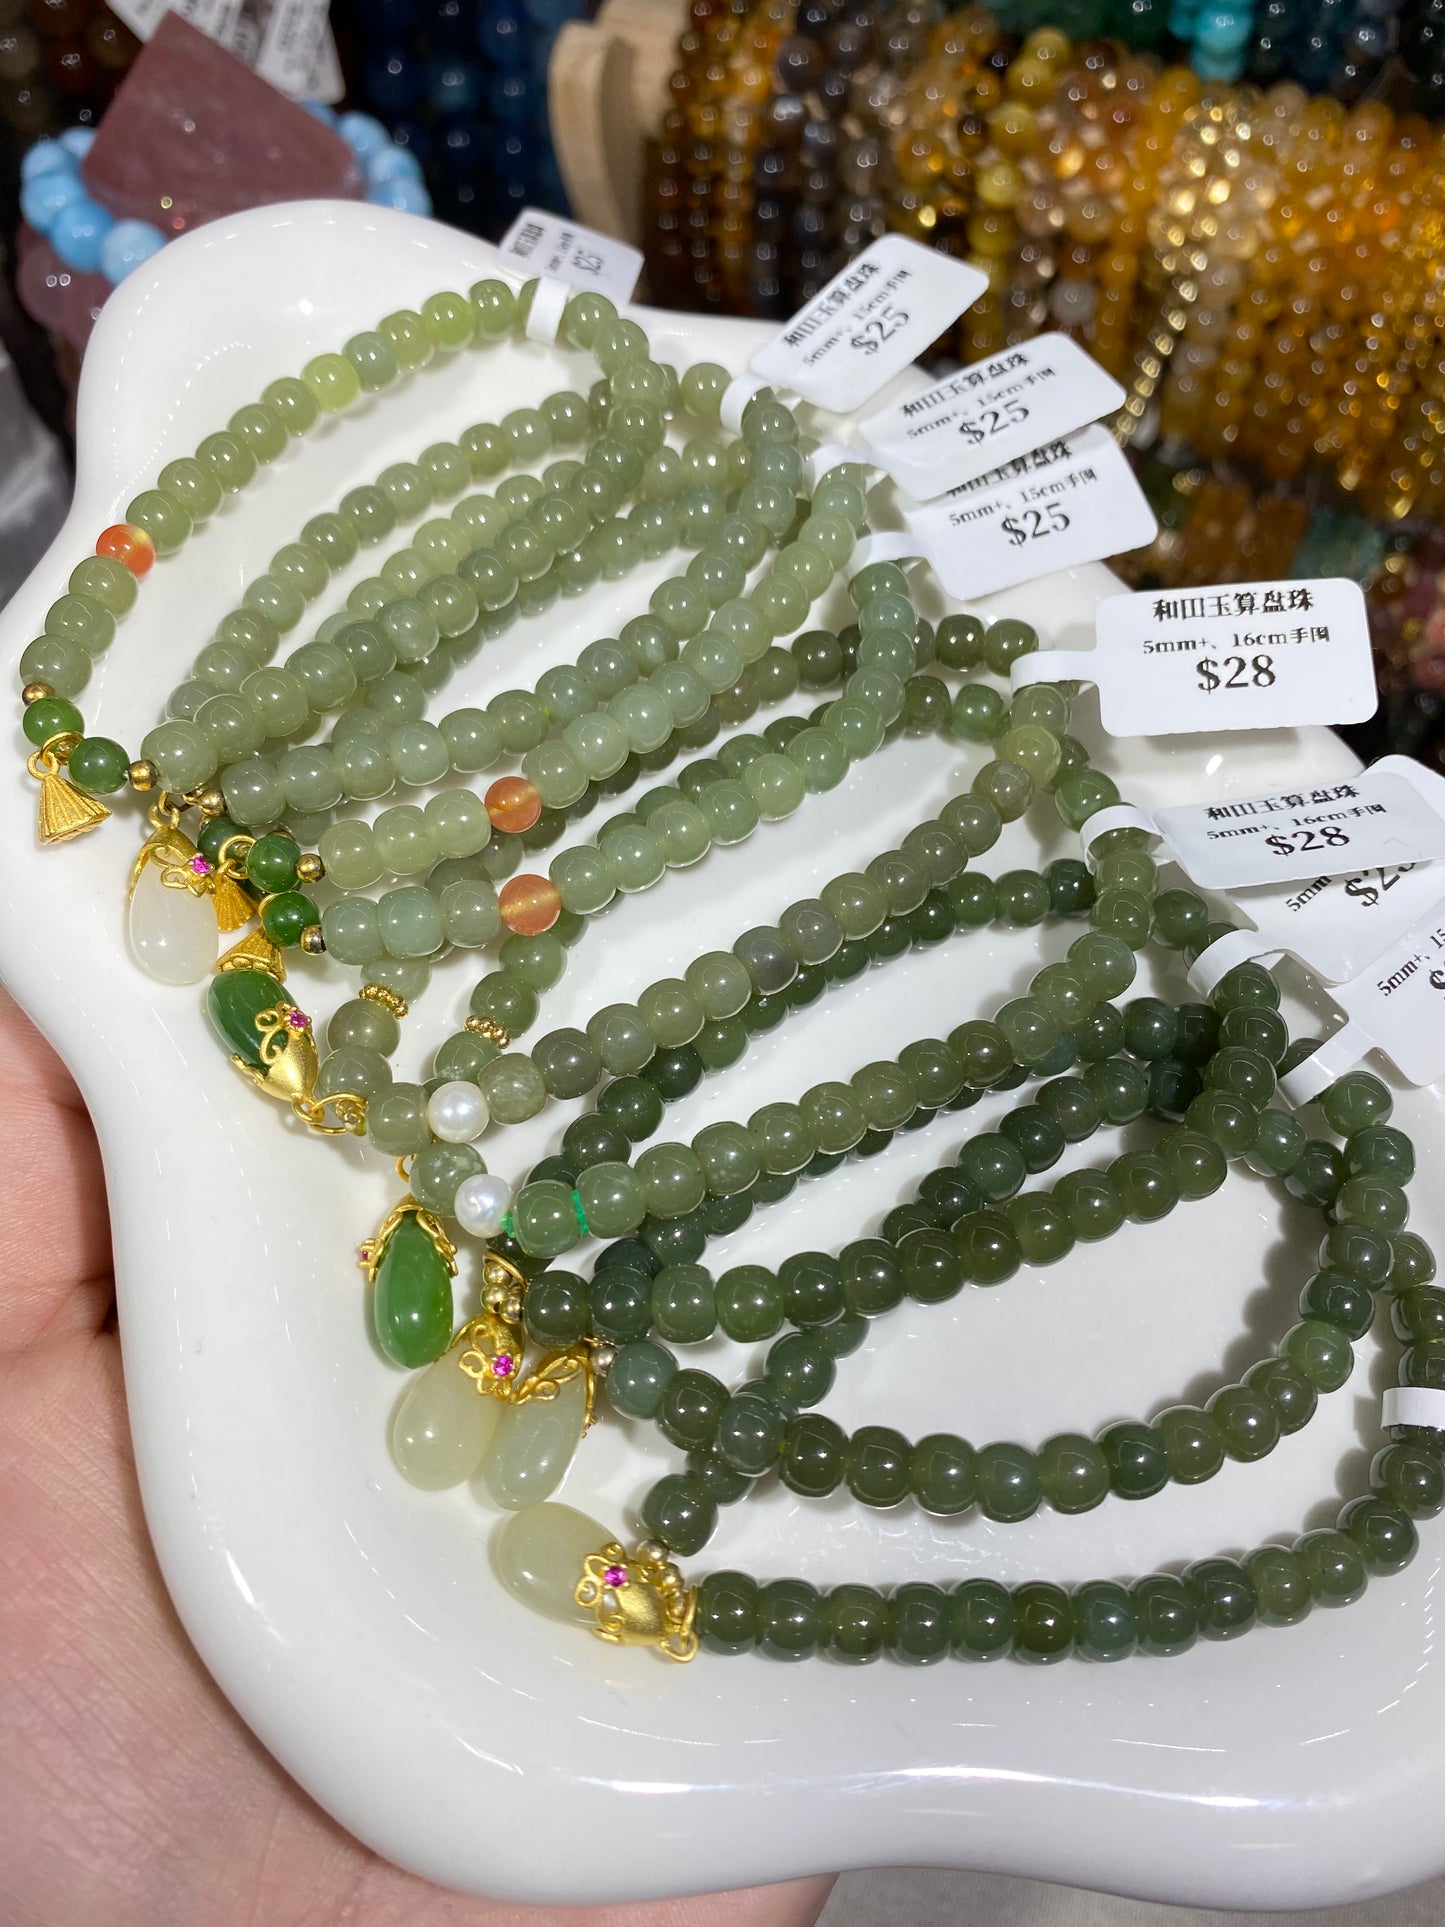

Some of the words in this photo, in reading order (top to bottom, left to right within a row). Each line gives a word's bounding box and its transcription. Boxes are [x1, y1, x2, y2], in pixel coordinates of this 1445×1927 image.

[850, 305, 910, 355] $25
[958, 399, 1030, 446] $25
[1000, 502, 1071, 548] $25
[1152, 587, 1315, 622] 和田玉算盘珠
[1196, 654, 1276, 695] $28
[1203, 784, 1361, 821] 和田玉算盘珠
[1264, 825, 1351, 857] $28
